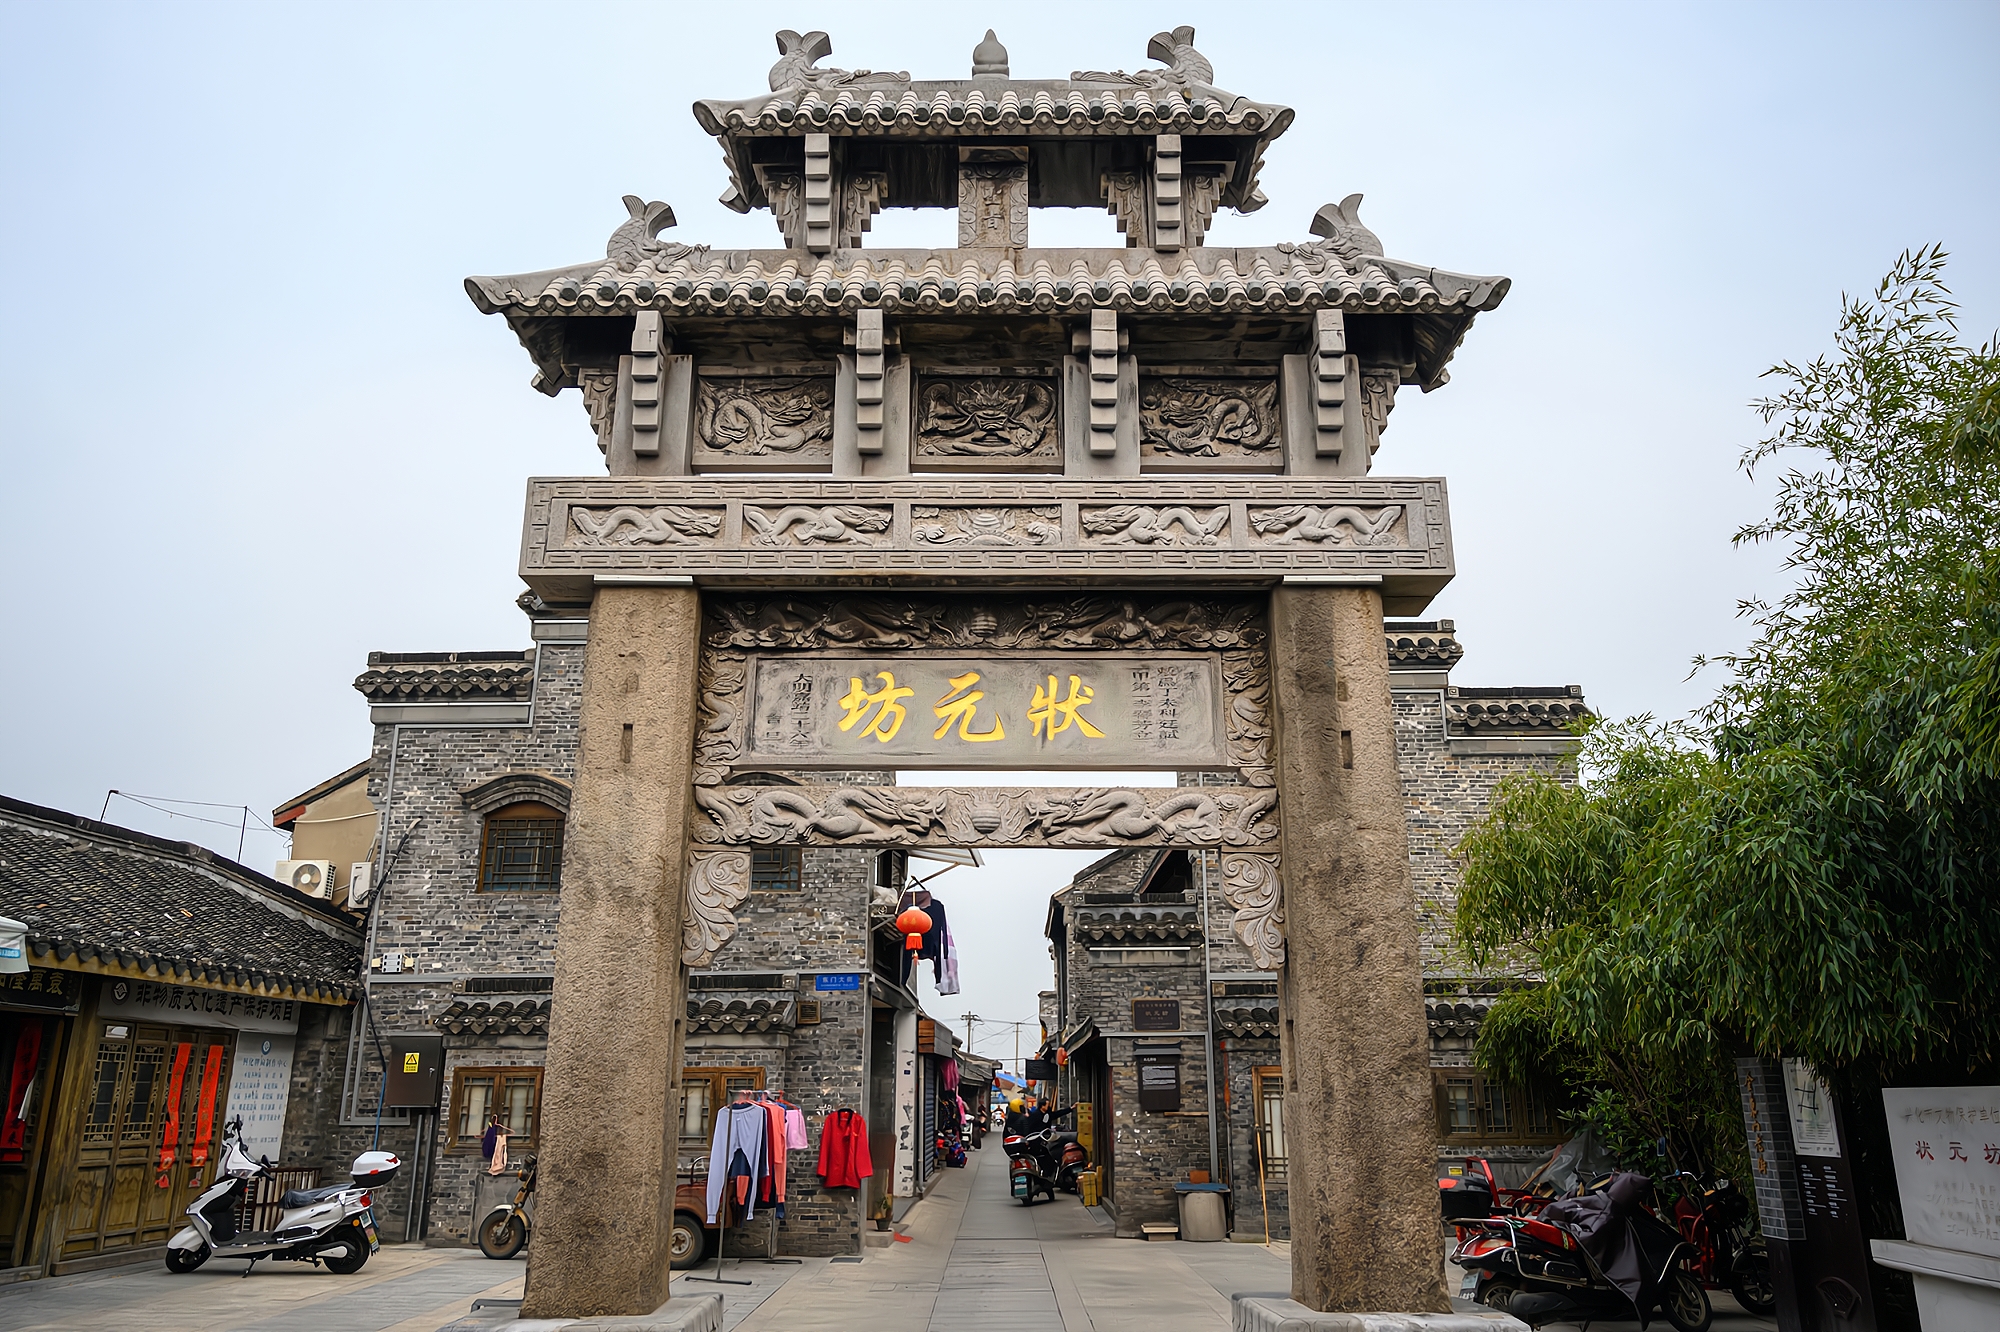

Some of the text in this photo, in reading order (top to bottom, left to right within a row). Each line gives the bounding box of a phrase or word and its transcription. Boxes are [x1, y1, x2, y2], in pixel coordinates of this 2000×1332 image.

[837, 671, 1107, 744] 狀元坊
[1915, 1140, 2000, 1166] 状元坊
